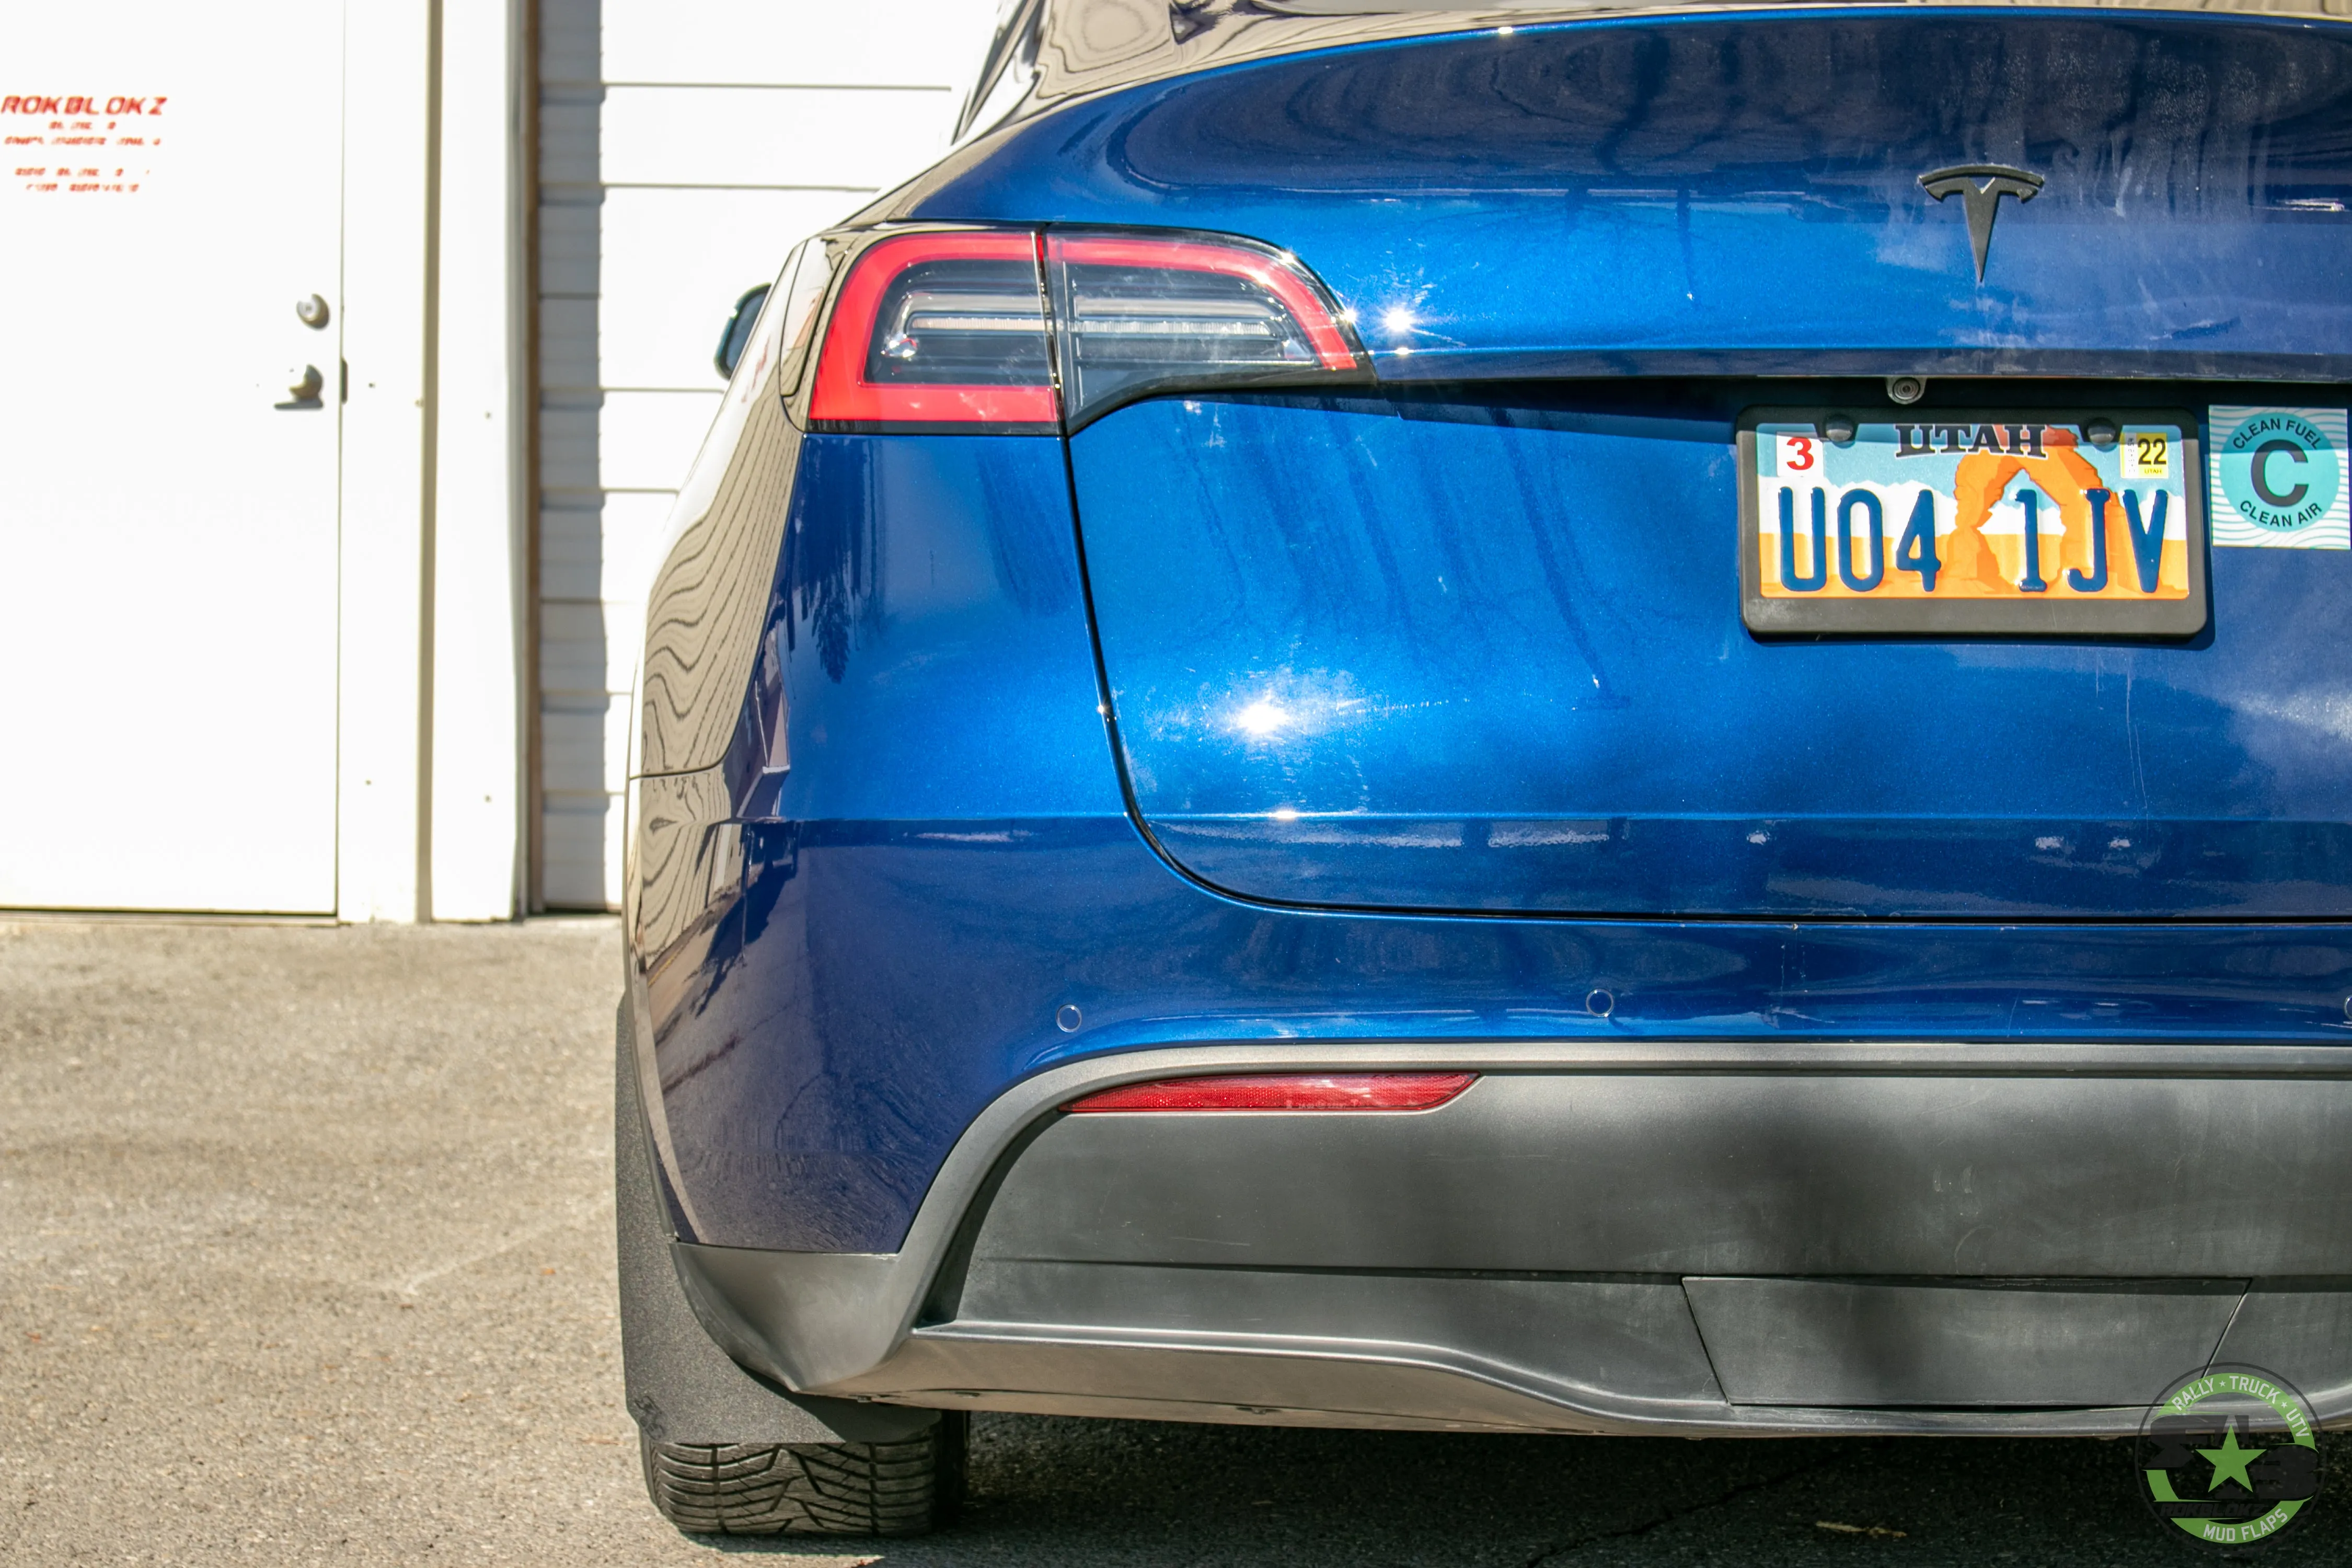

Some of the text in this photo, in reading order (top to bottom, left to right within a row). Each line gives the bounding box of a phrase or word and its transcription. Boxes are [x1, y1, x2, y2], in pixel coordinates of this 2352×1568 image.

[1894, 424, 2049, 459] UTAH
[2137, 437, 2166, 465] 22
[2232, 418, 2322, 450] CLEAN FUEL
[1786, 436, 1814, 470] 3
[2251, 439, 2309, 508] C
[2240, 500, 2323, 527] CLEAN AIR
[2014, 489, 2169, 593] 1JV
